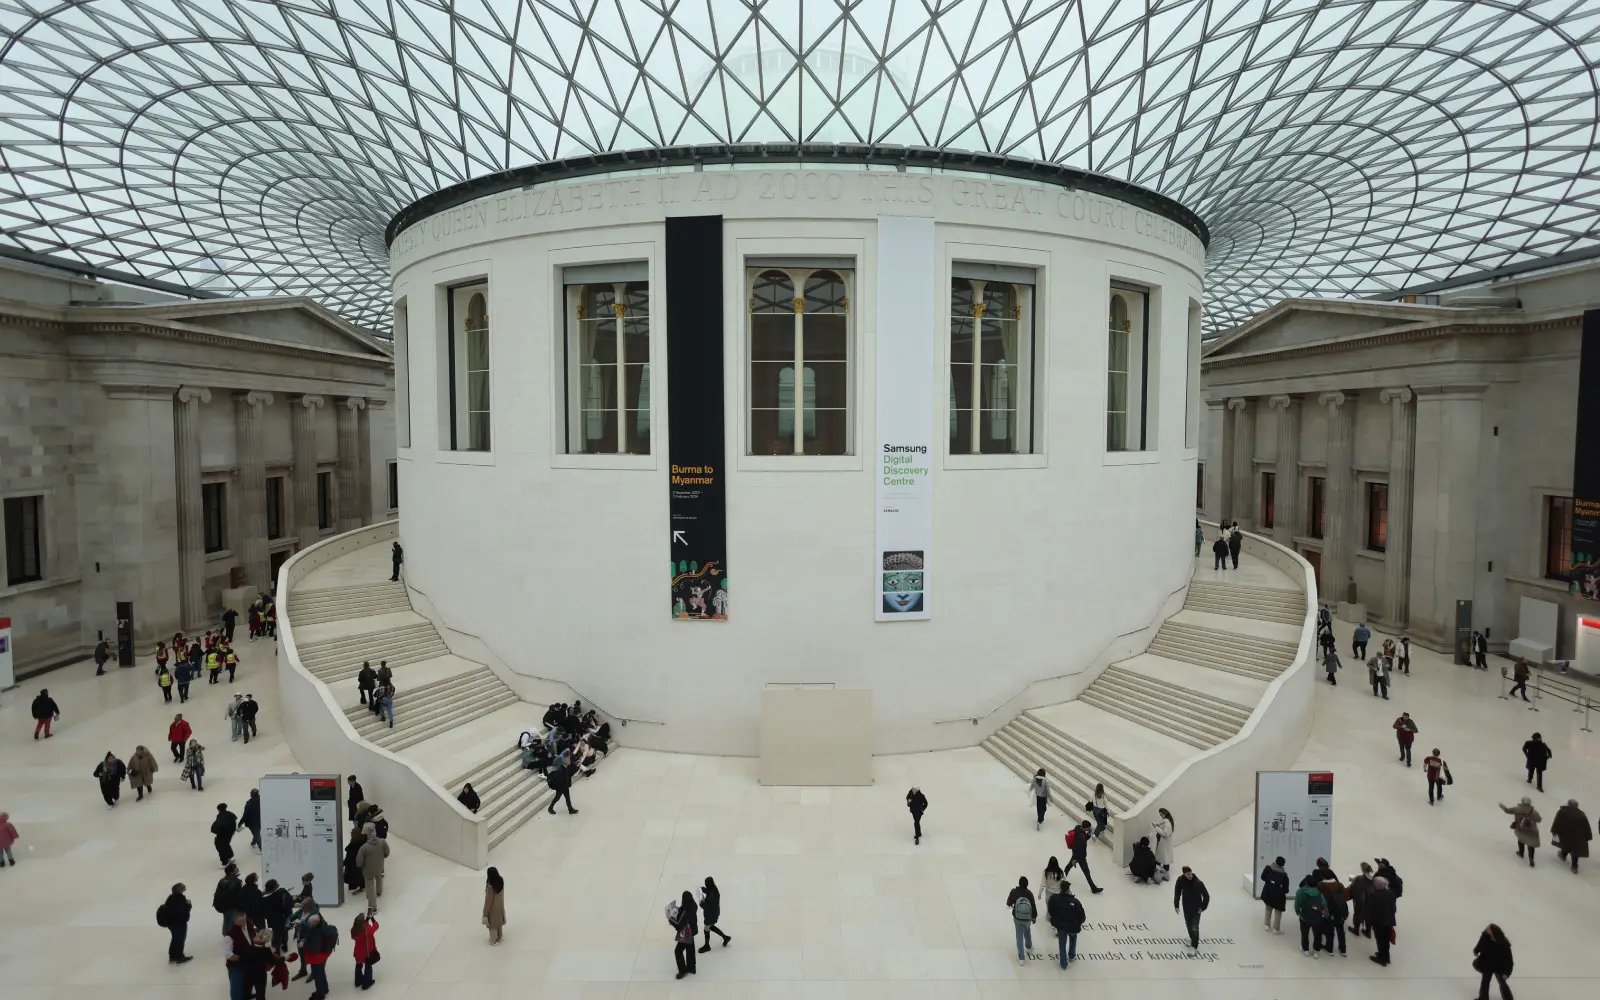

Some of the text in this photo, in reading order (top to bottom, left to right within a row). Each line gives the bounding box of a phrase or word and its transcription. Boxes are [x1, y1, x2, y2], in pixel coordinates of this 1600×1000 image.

[692, 174, 741, 202] AD
[759, 172, 843, 200] 2000
[858, 174, 935, 203] THIS
[951, 179, 1046, 214] GREAT
[1057, 193, 1128, 230] COURT
[883, 443, 927, 454] Samsung
[883, 455, 913, 465] Digital
[672, 464, 714, 474] Burma to
[883, 466, 929, 476] Discovery
[672, 475, 714, 486] Myanmar
[883, 477, 915, 486] Centre
[1080, 922, 1150, 932] et thy feet
[1026, 951, 1043, 960] be
[1089, 950, 1126, 960] midst
[1130, 950, 1145, 960] of
[1149, 950, 1221, 963] knowledge
